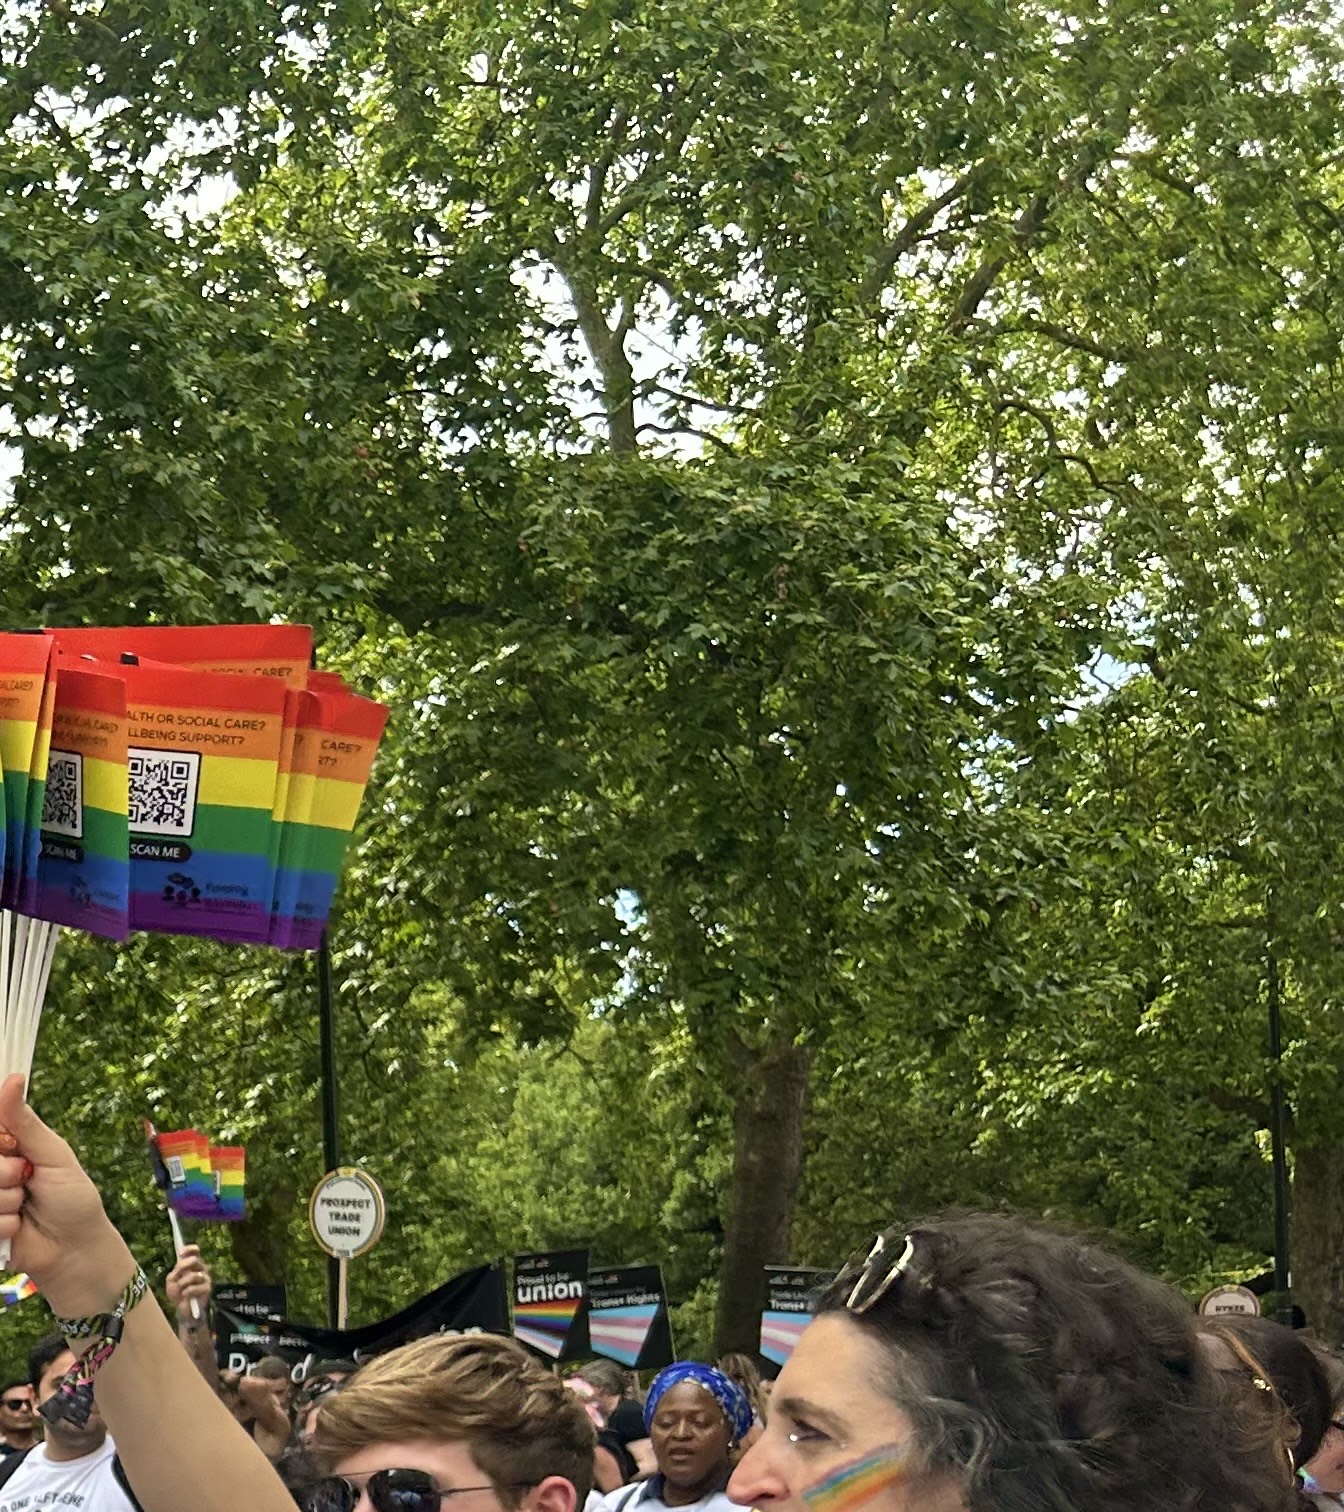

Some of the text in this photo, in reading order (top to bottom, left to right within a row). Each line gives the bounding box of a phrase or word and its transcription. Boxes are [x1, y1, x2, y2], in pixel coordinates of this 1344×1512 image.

[126, 710, 266, 731] ALTH OR SOCIAL CARE?
[127, 727, 176, 743] LLBEING
[178, 731, 245, 746] SUPPORT?
[320, 739, 363, 754] CARE?
[130, 844, 181, 859] SCAN ME
[320, 1198, 371, 1209] PROSPECT
[329, 1211, 361, 1223] TRADE
[328, 1226, 360, 1236] UNION
[517, 1281, 583, 1303] union
[229, 1352, 313, 1385] Prd
